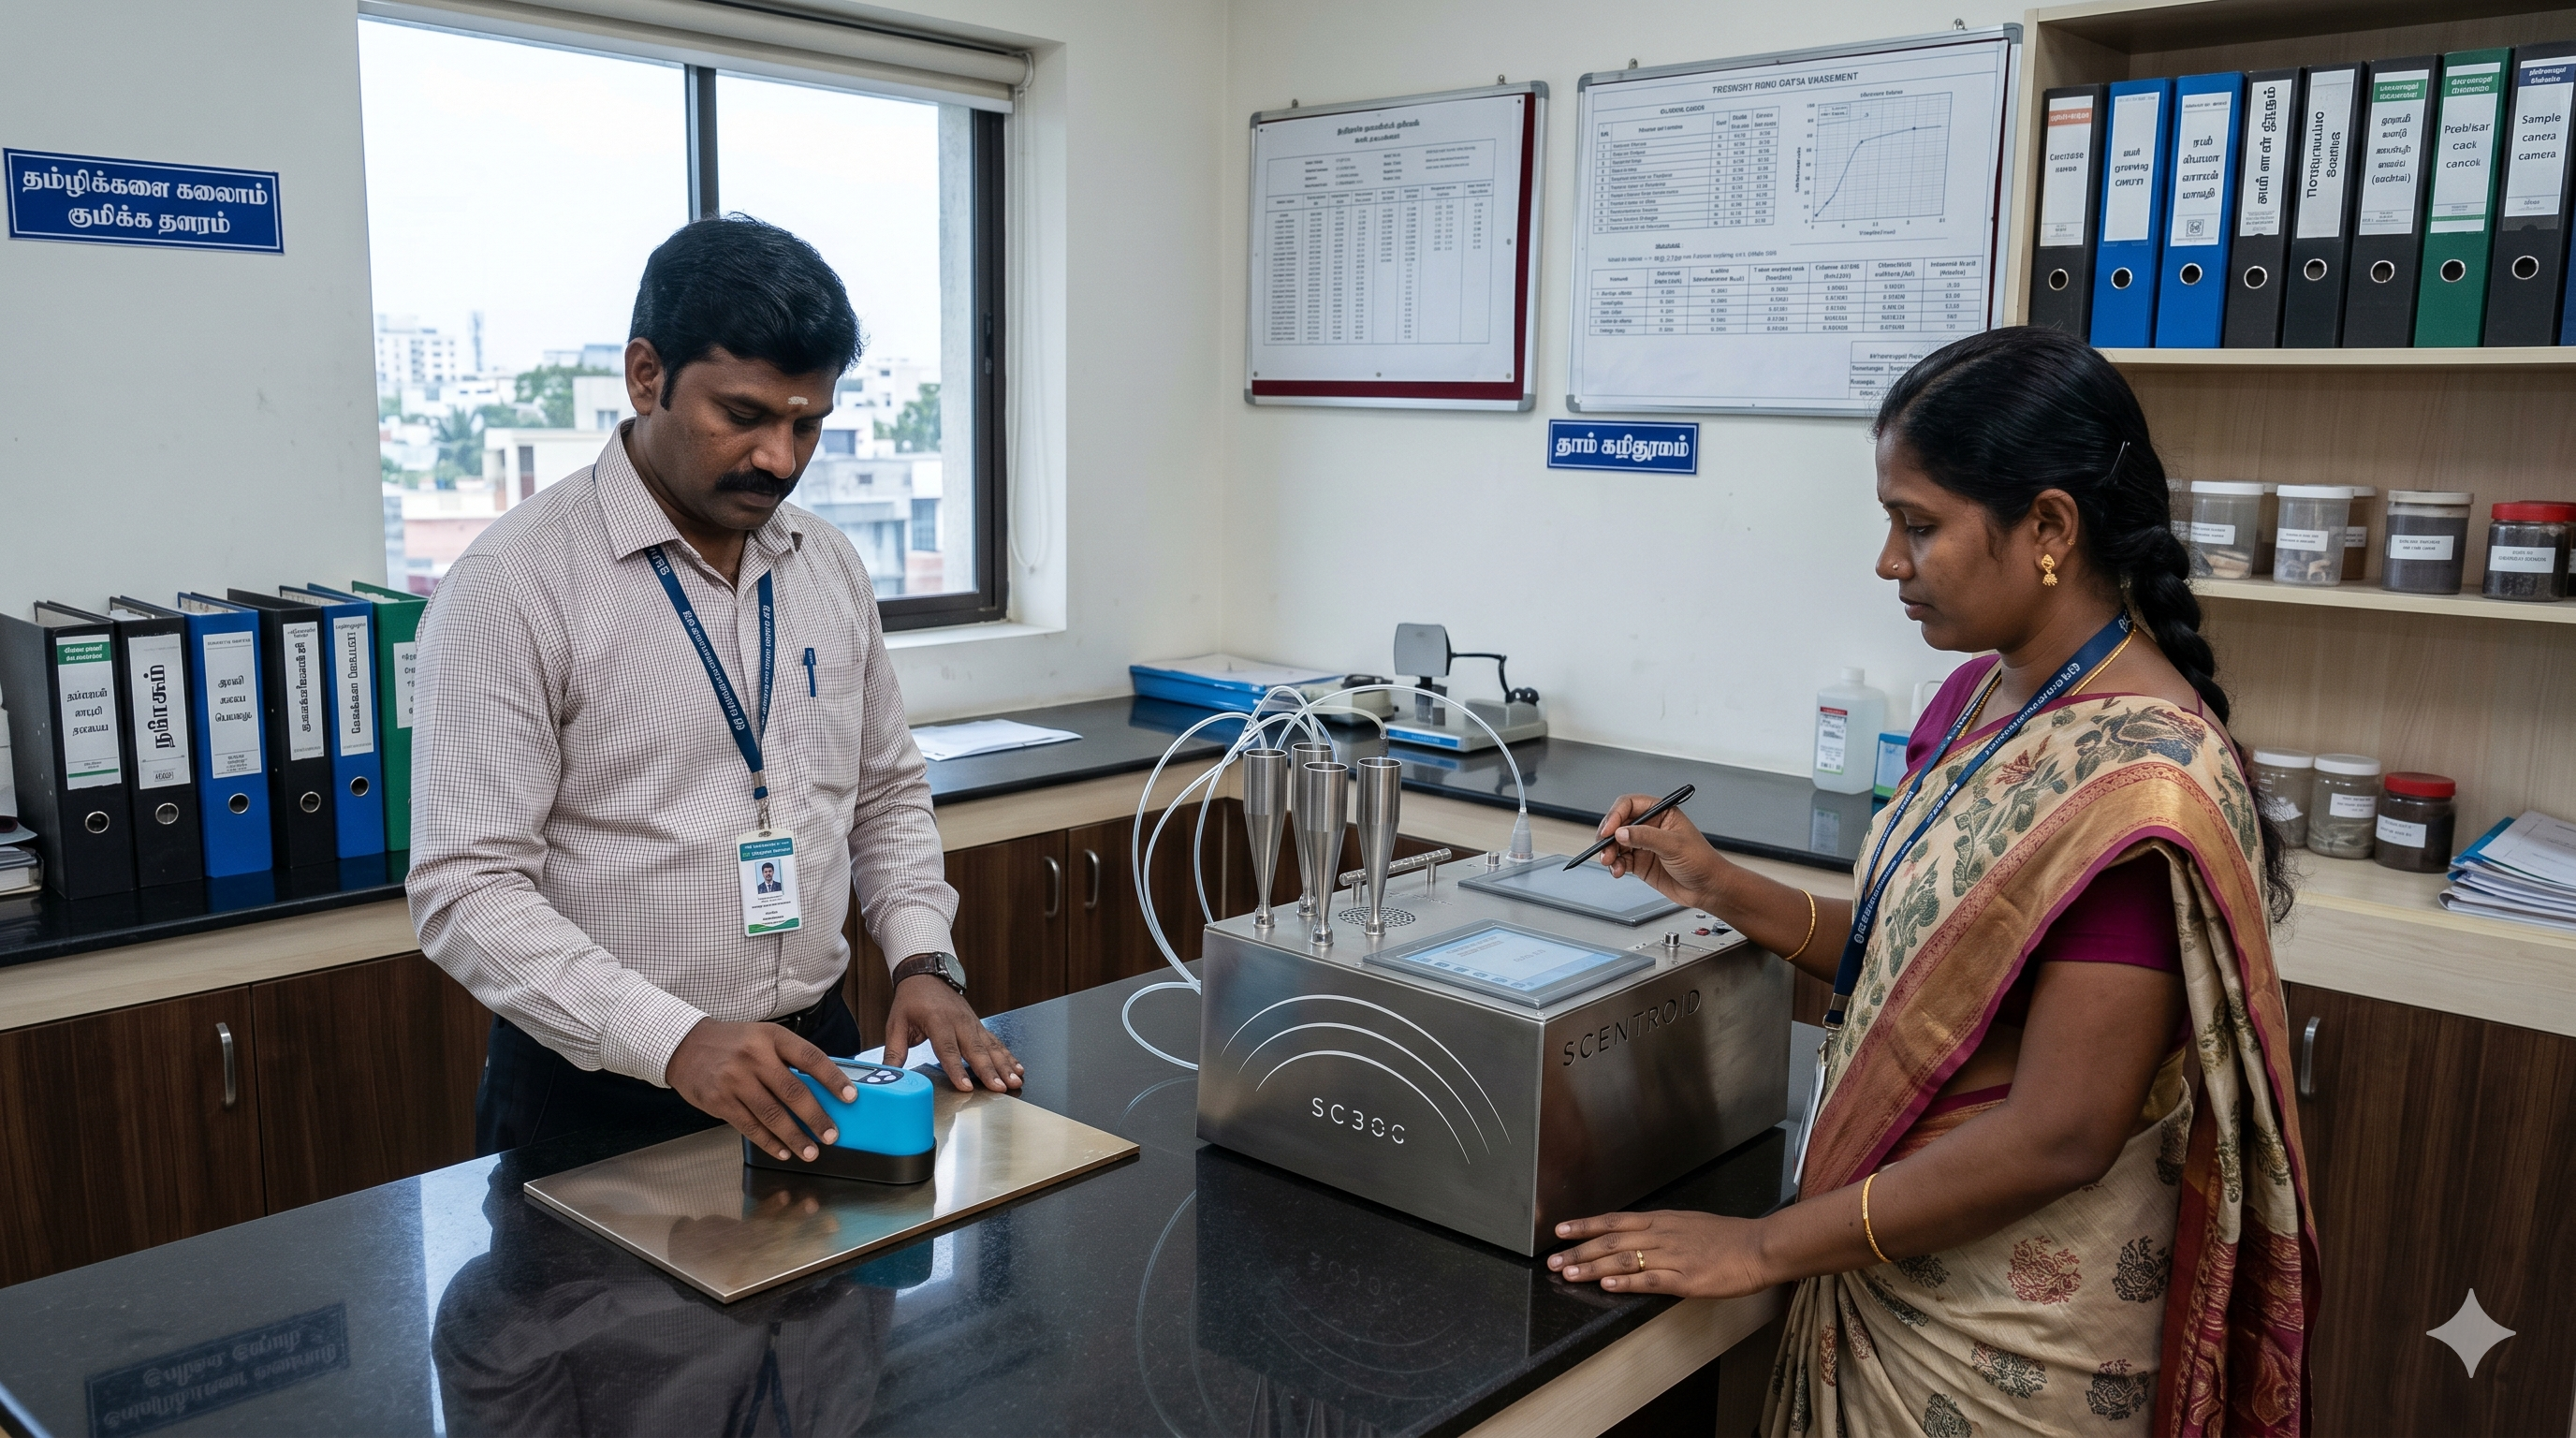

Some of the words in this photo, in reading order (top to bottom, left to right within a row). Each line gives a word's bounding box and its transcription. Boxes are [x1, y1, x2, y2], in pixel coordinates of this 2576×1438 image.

[2522, 112, 2562, 125] Sample
[2522, 132, 2556, 142] canera
[2518, 150, 2556, 161] camera
[1555, 432, 1598, 457] தாம்
[1563, 989, 1702, 1067] SCENTROID
